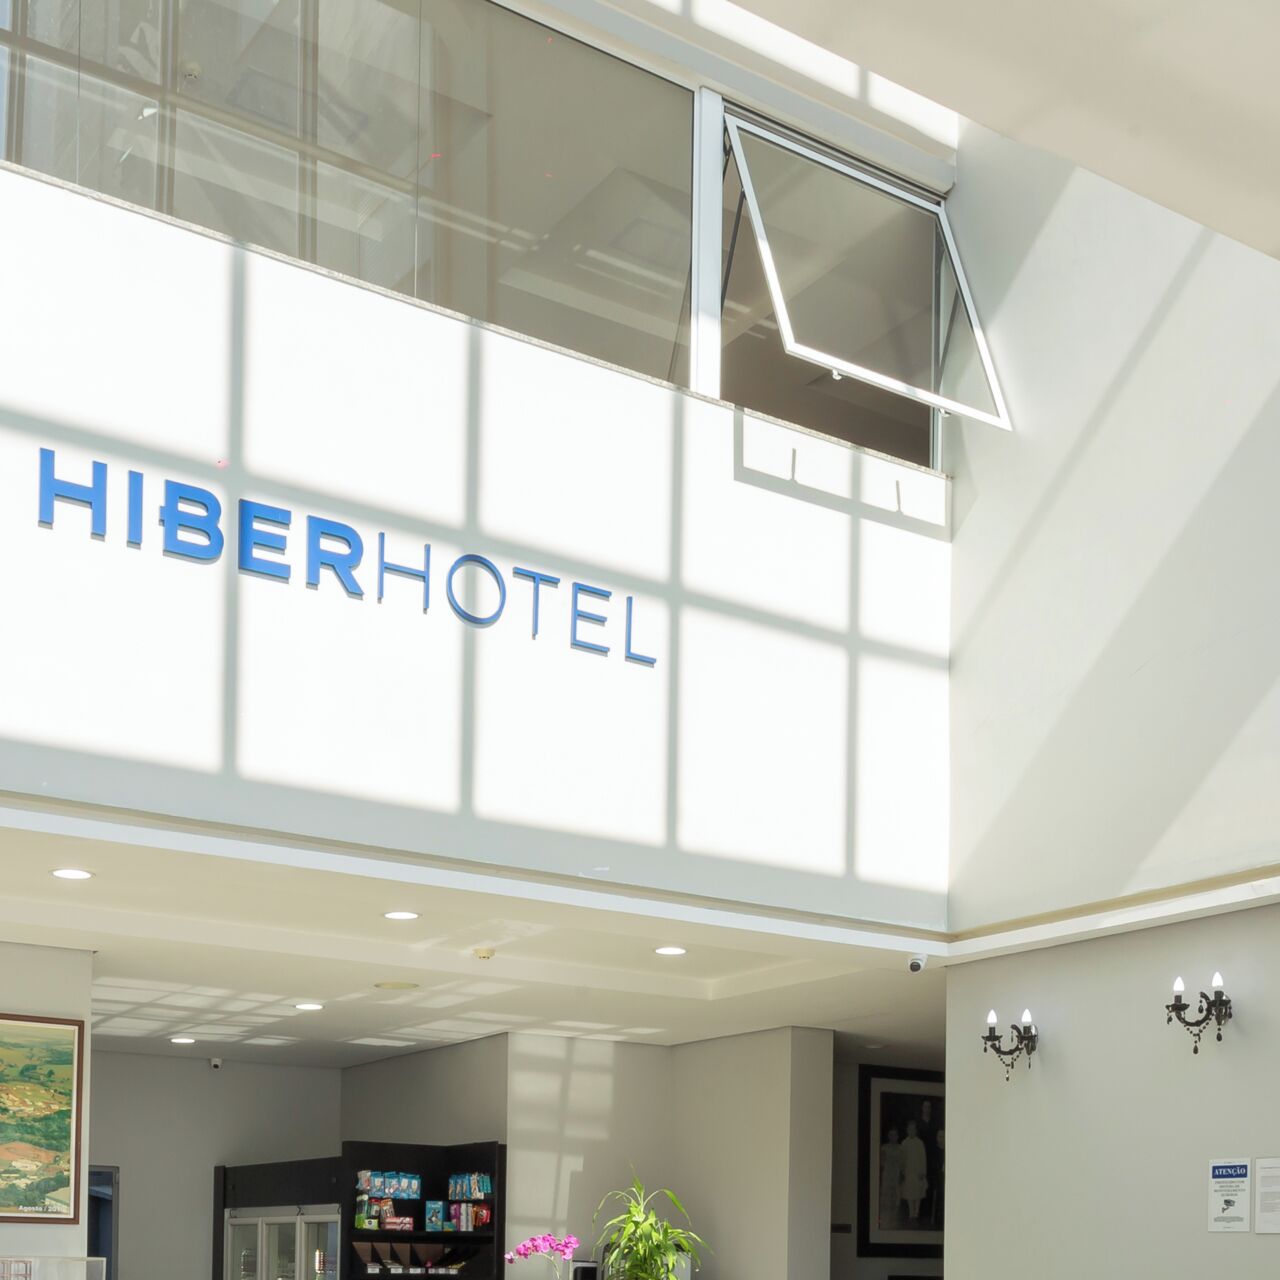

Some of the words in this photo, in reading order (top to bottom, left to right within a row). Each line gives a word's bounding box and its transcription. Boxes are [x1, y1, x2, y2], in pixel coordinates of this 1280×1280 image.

[36, 446, 658, 668] HIBERHOTEL
[1214, 1167, 1246, 1176] ATENÇÃO
[18, 1204, 43, 1212] Agosto
